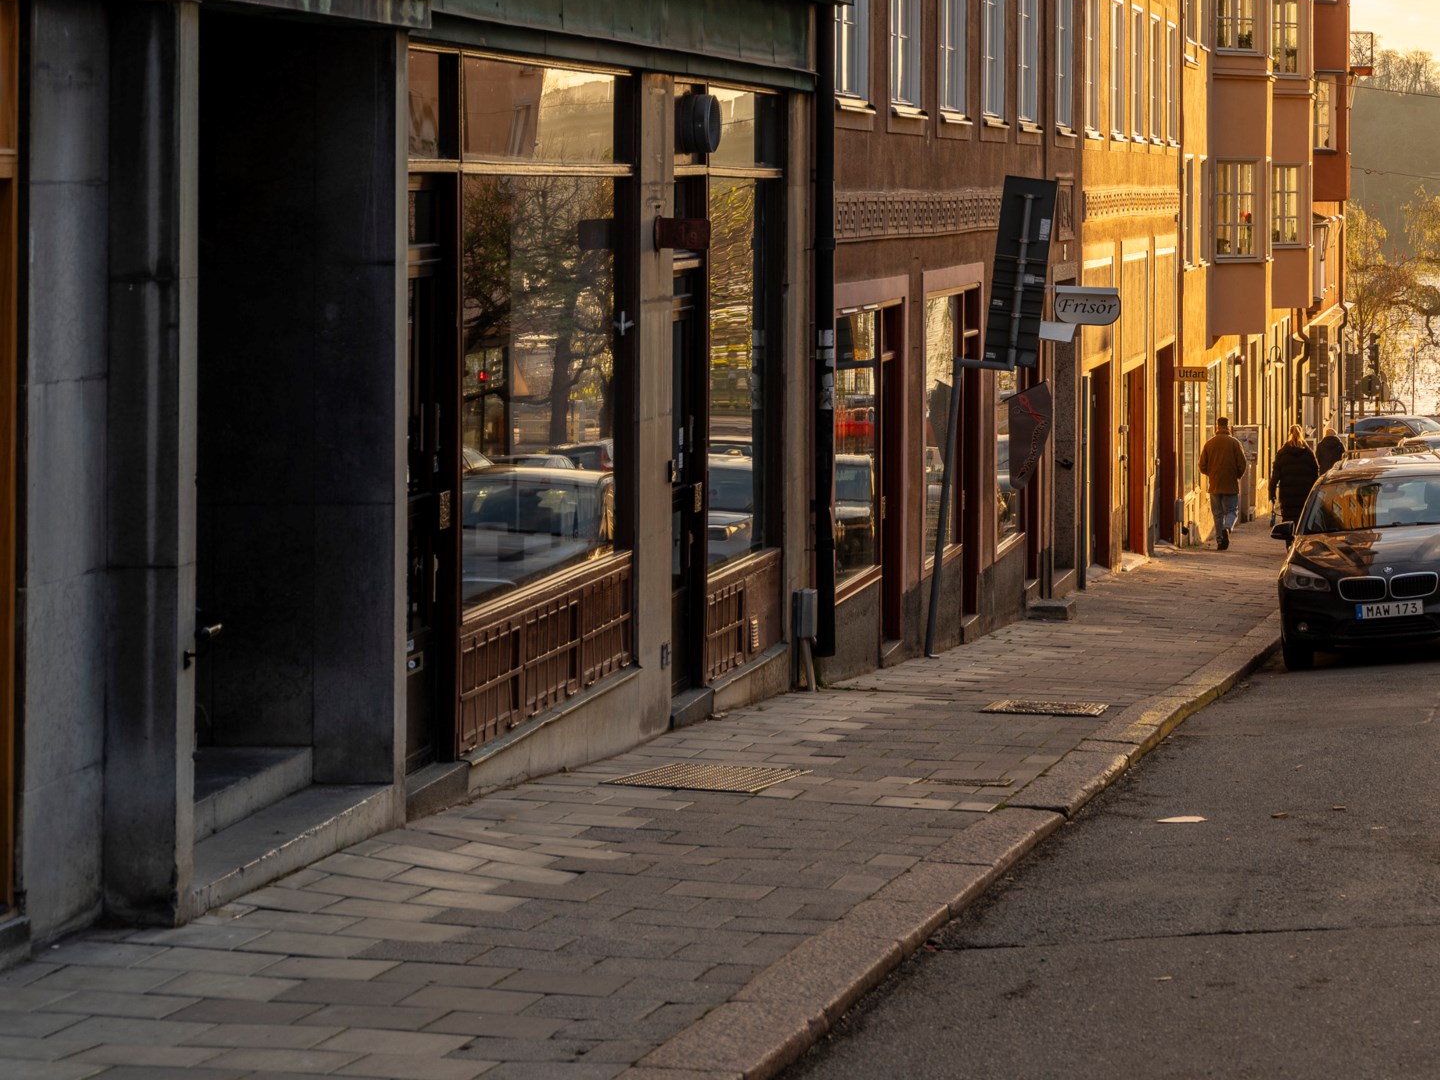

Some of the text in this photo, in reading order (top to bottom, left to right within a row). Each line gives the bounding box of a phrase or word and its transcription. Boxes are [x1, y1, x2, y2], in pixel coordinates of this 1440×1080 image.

[1058, 298, 1117, 315] Frisör
[1178, 369, 1205, 378] Utfart
[1366, 602, 1418, 617] MAW 173
